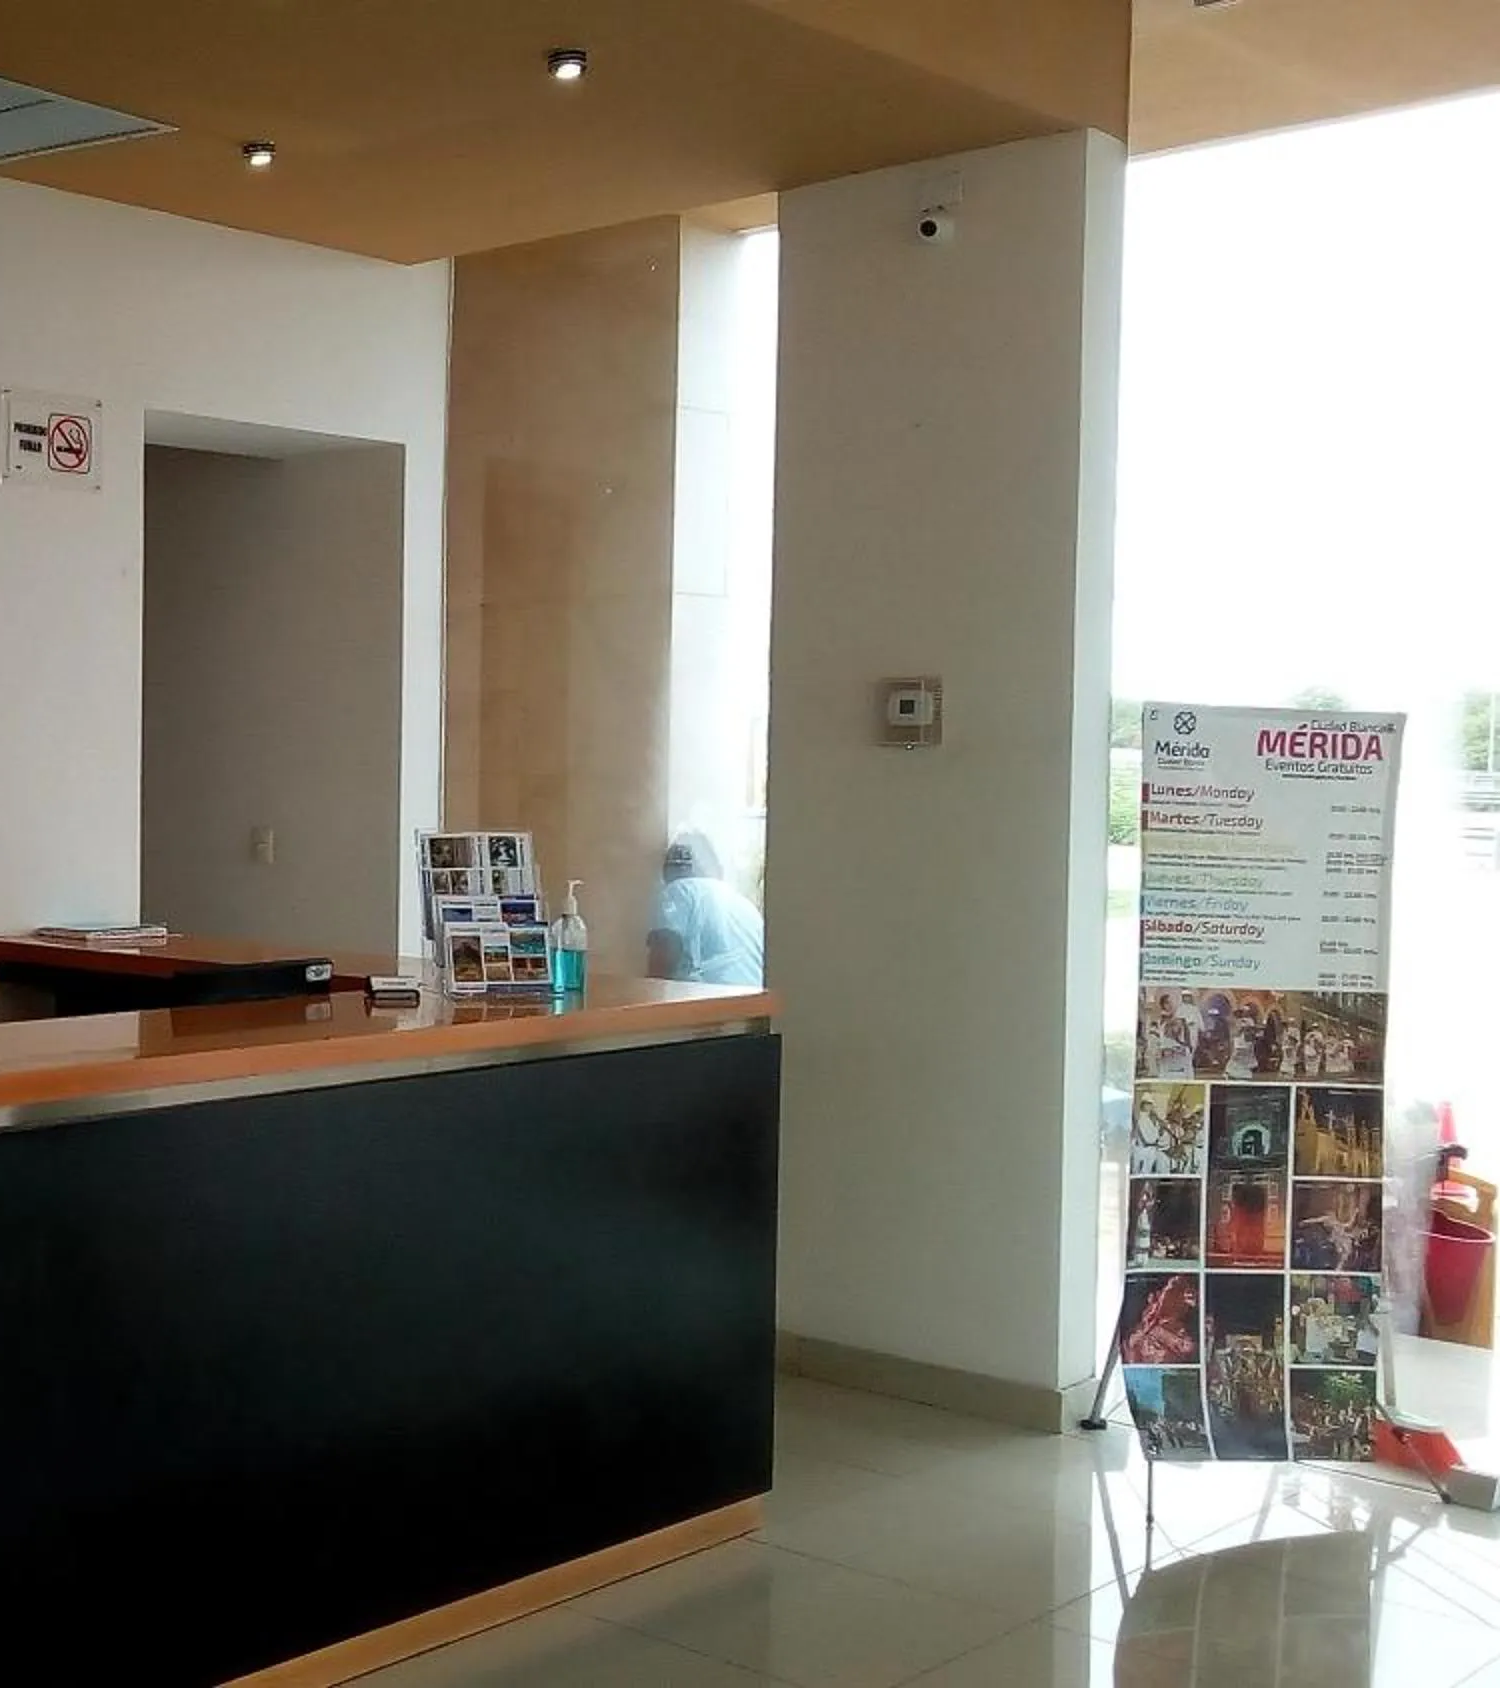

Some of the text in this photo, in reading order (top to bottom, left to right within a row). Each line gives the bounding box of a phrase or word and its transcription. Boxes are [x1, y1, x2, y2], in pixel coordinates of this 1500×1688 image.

[1154, 740, 1211, 759] Mérida
[1257, 723, 1384, 761] MÉRIDA
[1265, 758, 1373, 775] Eventos Gratuitos
[1151, 783, 1255, 802] Lunes/Monday
[1150, 811, 1263, 830] Martes/Tuesday
